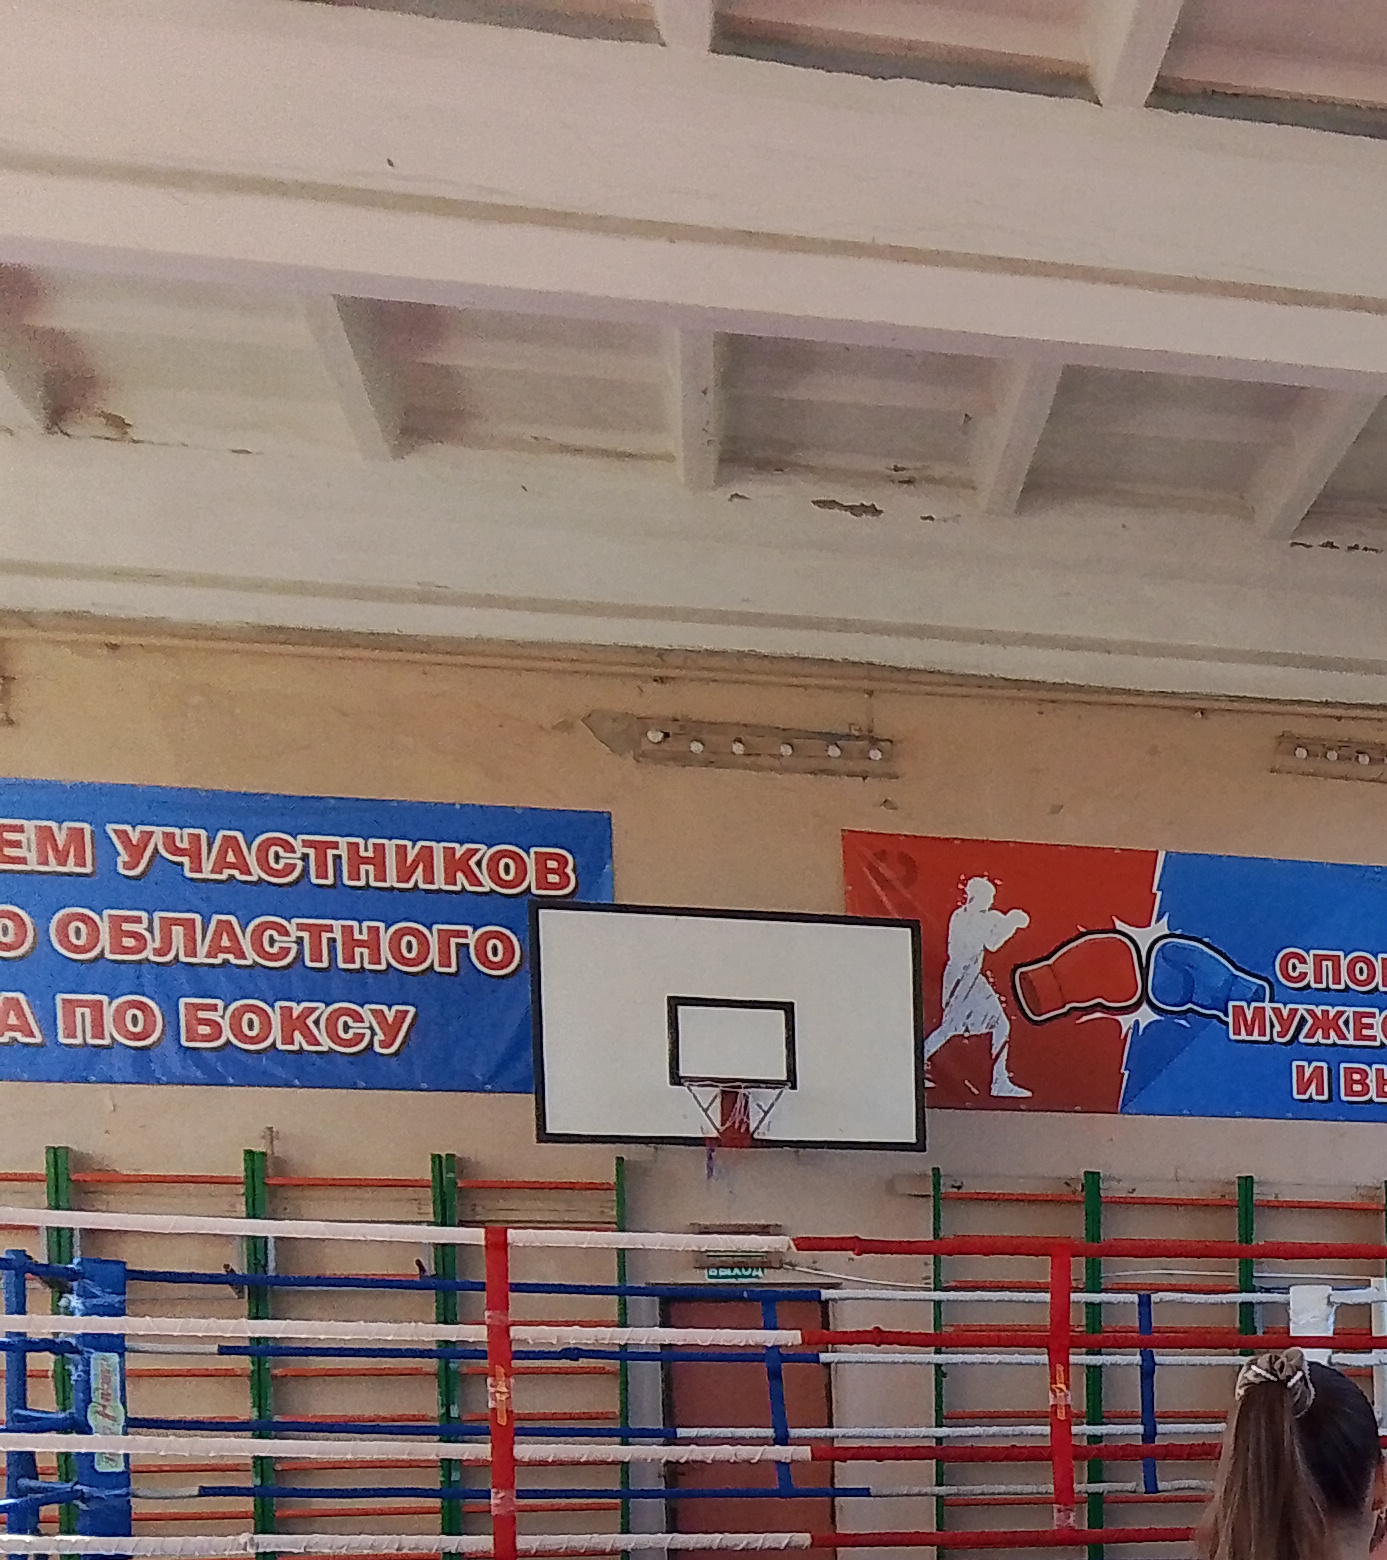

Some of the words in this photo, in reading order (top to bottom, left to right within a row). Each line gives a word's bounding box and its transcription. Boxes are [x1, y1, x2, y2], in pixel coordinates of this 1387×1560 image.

[105, 823, 578, 897] УЧАСТНИКОВ
[49, 907, 524, 976] ОБЛАСТНОГО
[56, 993, 164, 1048] ПО
[179, 998, 416, 1055] БОКСУ
[1291, 1060, 1328, 1100] И
